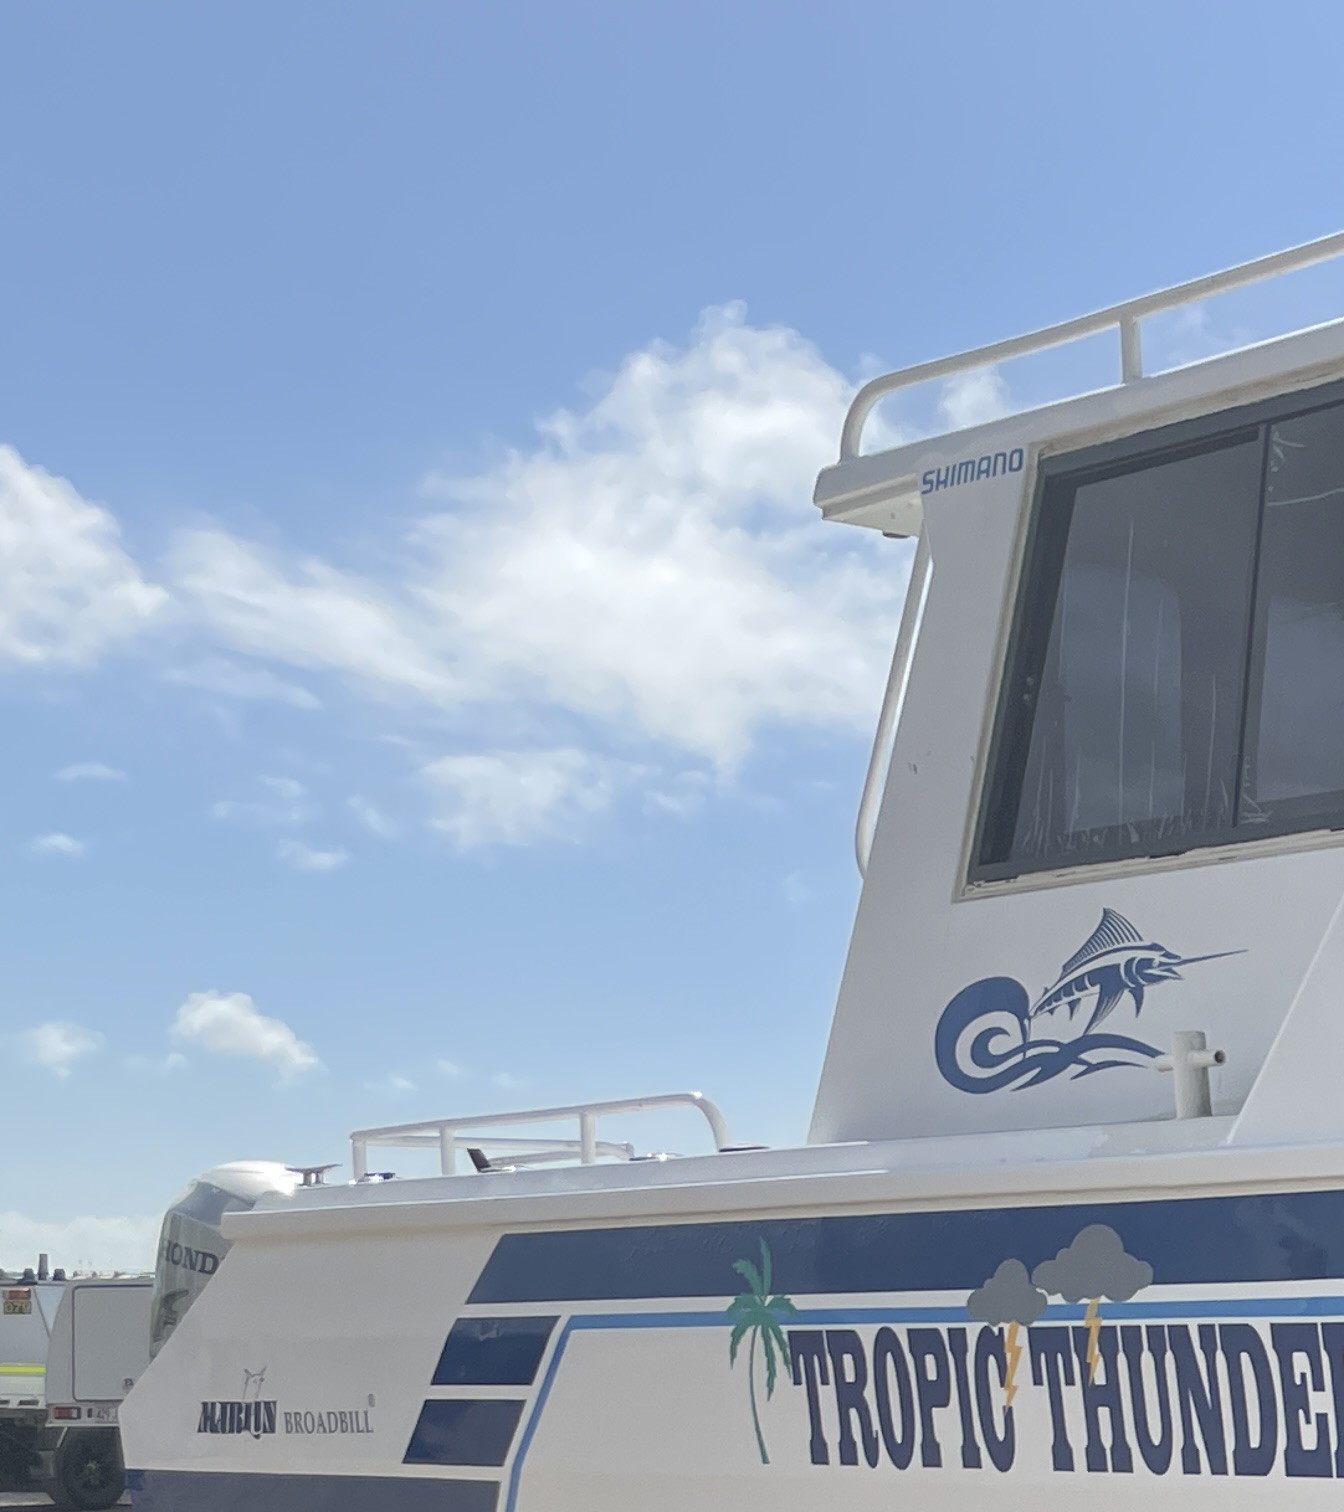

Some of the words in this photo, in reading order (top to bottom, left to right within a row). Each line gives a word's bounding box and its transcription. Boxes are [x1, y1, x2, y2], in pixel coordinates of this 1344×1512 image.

[921, 448, 1024, 495] SHIMANO
[164, 1239, 225, 1275] OND
[787, 1325, 1016, 1473] TROPIC
[283, 1410, 374, 1435] BROADBILL
